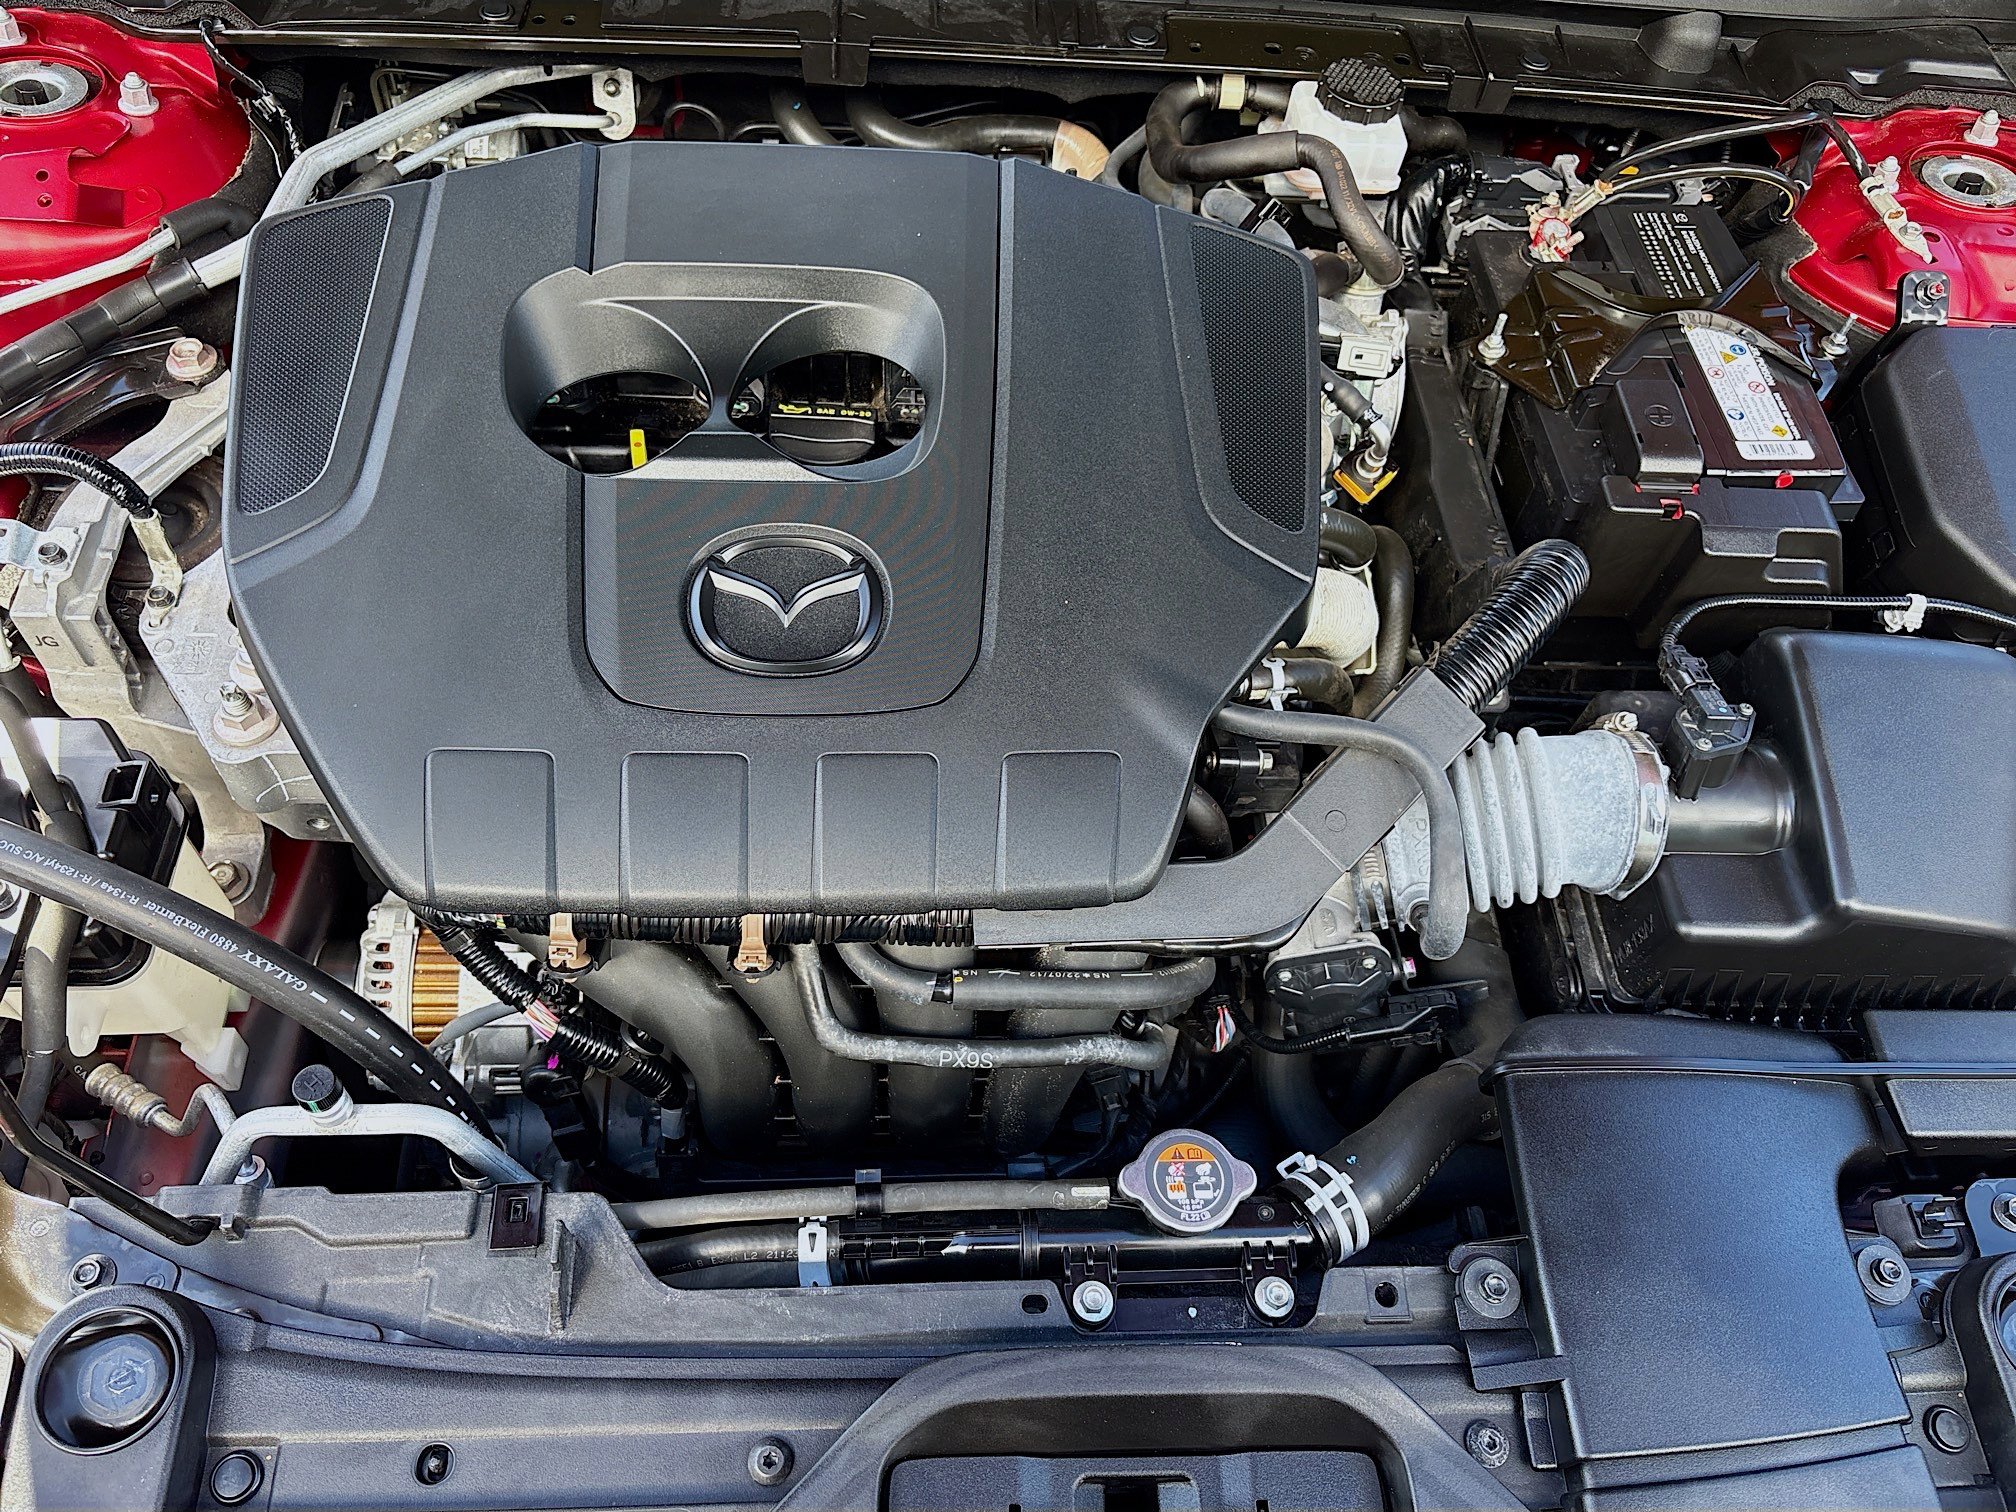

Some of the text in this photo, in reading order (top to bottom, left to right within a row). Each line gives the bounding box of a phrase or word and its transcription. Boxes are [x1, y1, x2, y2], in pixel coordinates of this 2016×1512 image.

[840, 410, 872, 418] 0W-20
[35, 635, 59, 647] JG
[23, 848, 46, 863] A/C
[43, 858, 92, 885] R-1234yf
[100, 882, 140, 905] R-134a
[142, 900, 210, 939] FlexBarrier
[209, 934, 239, 953] 4880
[237, 949, 308, 992] GALAXY
[938, 1050, 994, 1069] PX9S
[1180, 1212, 1200, 1221] FL22
[743, 1252, 758, 1260] L2
